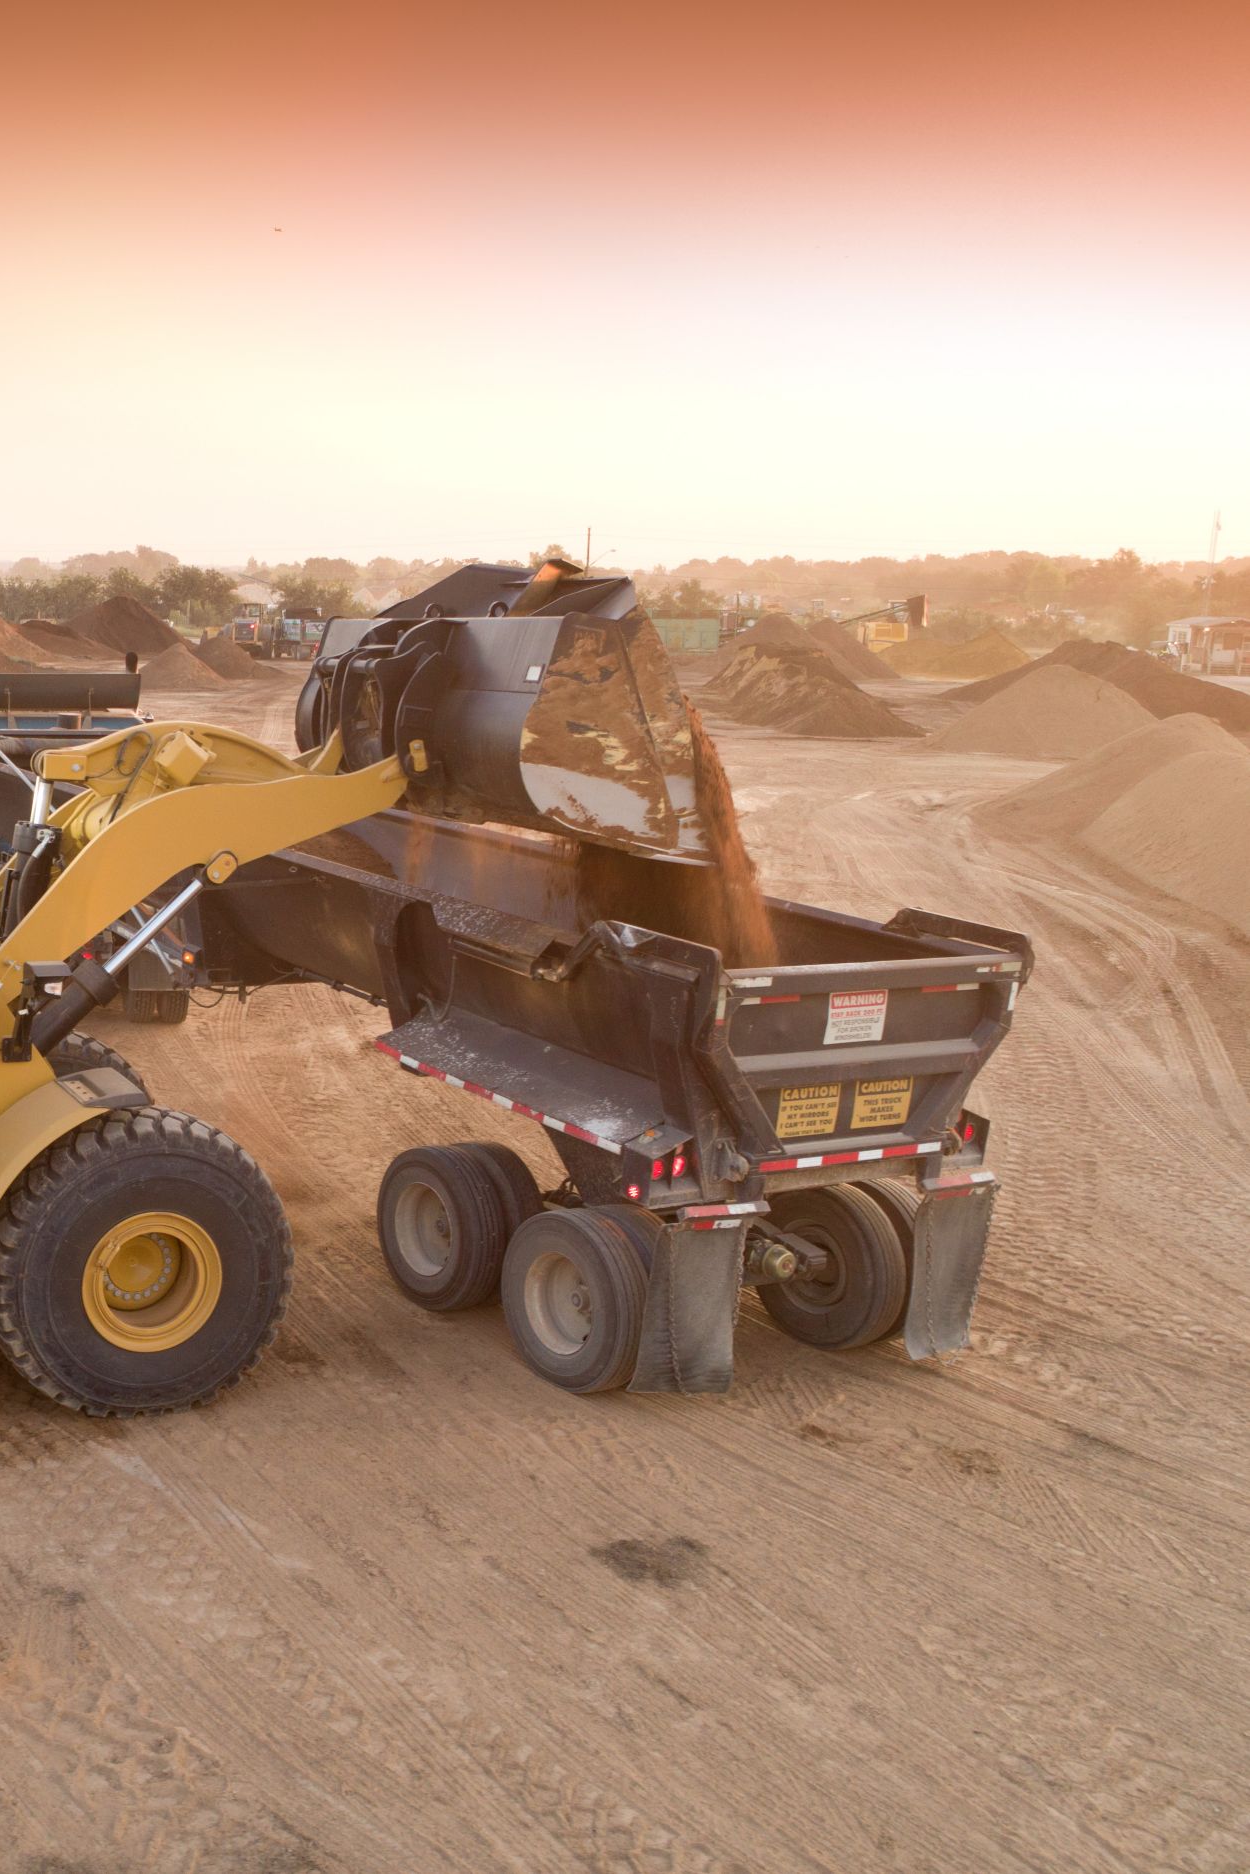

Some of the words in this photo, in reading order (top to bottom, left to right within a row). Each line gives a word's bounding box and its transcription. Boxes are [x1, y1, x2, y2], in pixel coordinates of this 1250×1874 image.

[833, 993, 884, 1007] WARNING
[784, 1085, 837, 1099] CAUTION
[861, 1079, 907, 1092] CAUTION
[827, 1101, 838, 1109] SEE
[880, 1112, 901, 1120] TURNS
